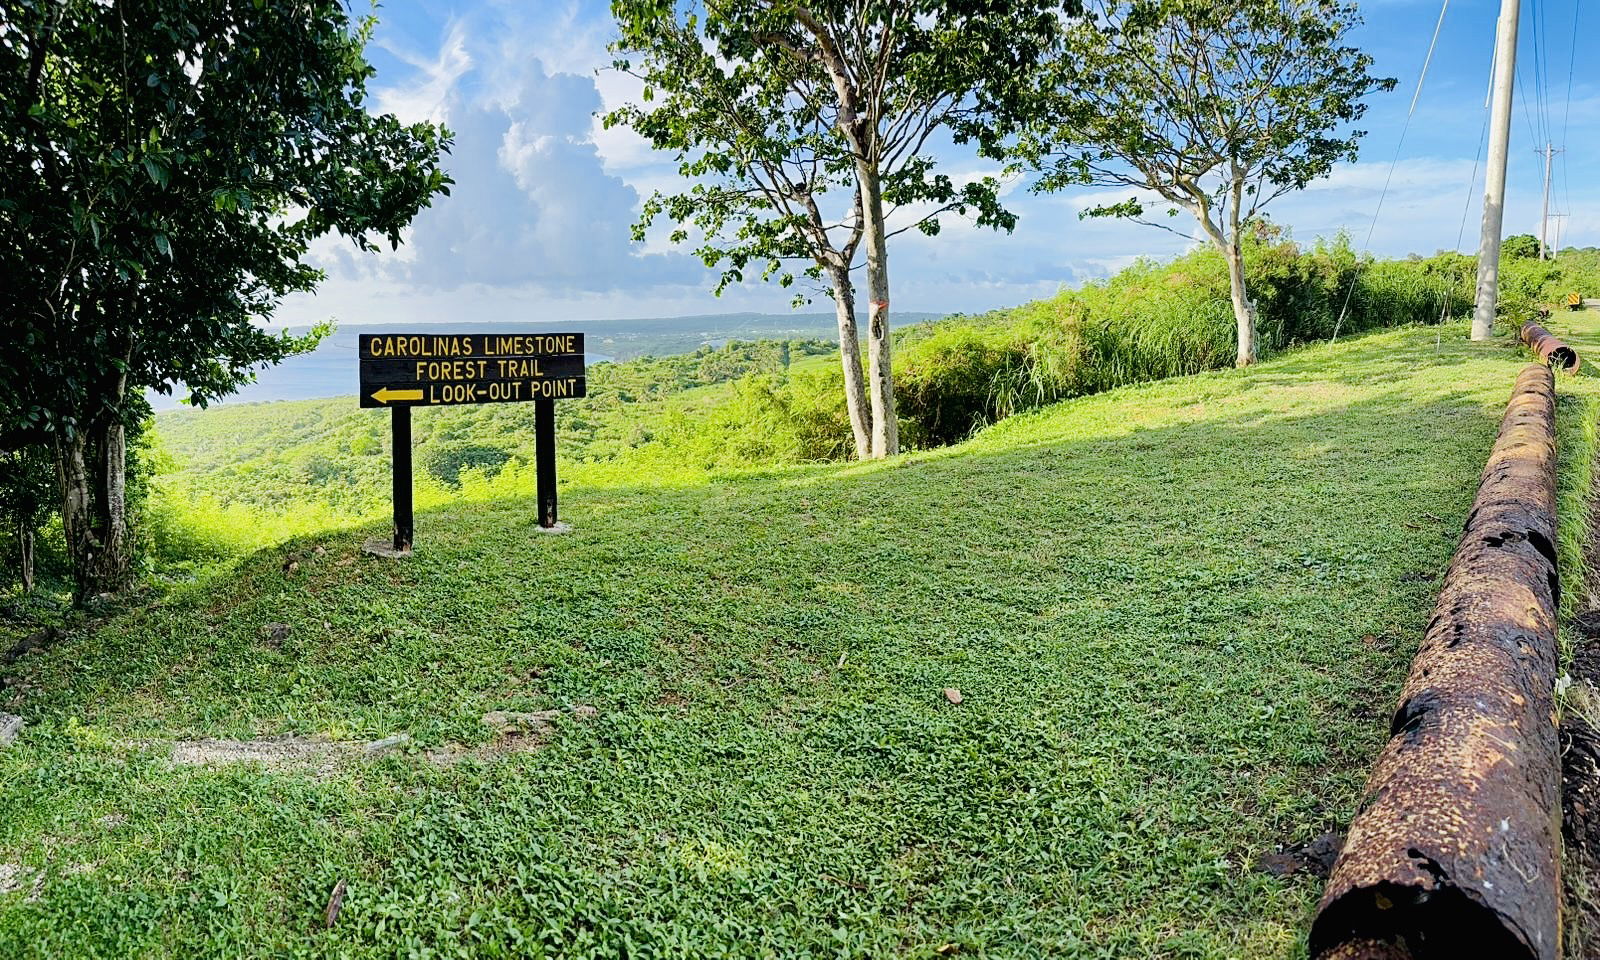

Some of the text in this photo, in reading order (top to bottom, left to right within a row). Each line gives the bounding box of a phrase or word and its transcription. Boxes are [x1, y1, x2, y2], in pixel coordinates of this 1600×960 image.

[370, 335, 575, 357] CAROLINAS LIMESTONE
[416, 359, 544, 381] FOREST TRAIL
[430, 378, 577, 404] LOOK-OUT POINT
